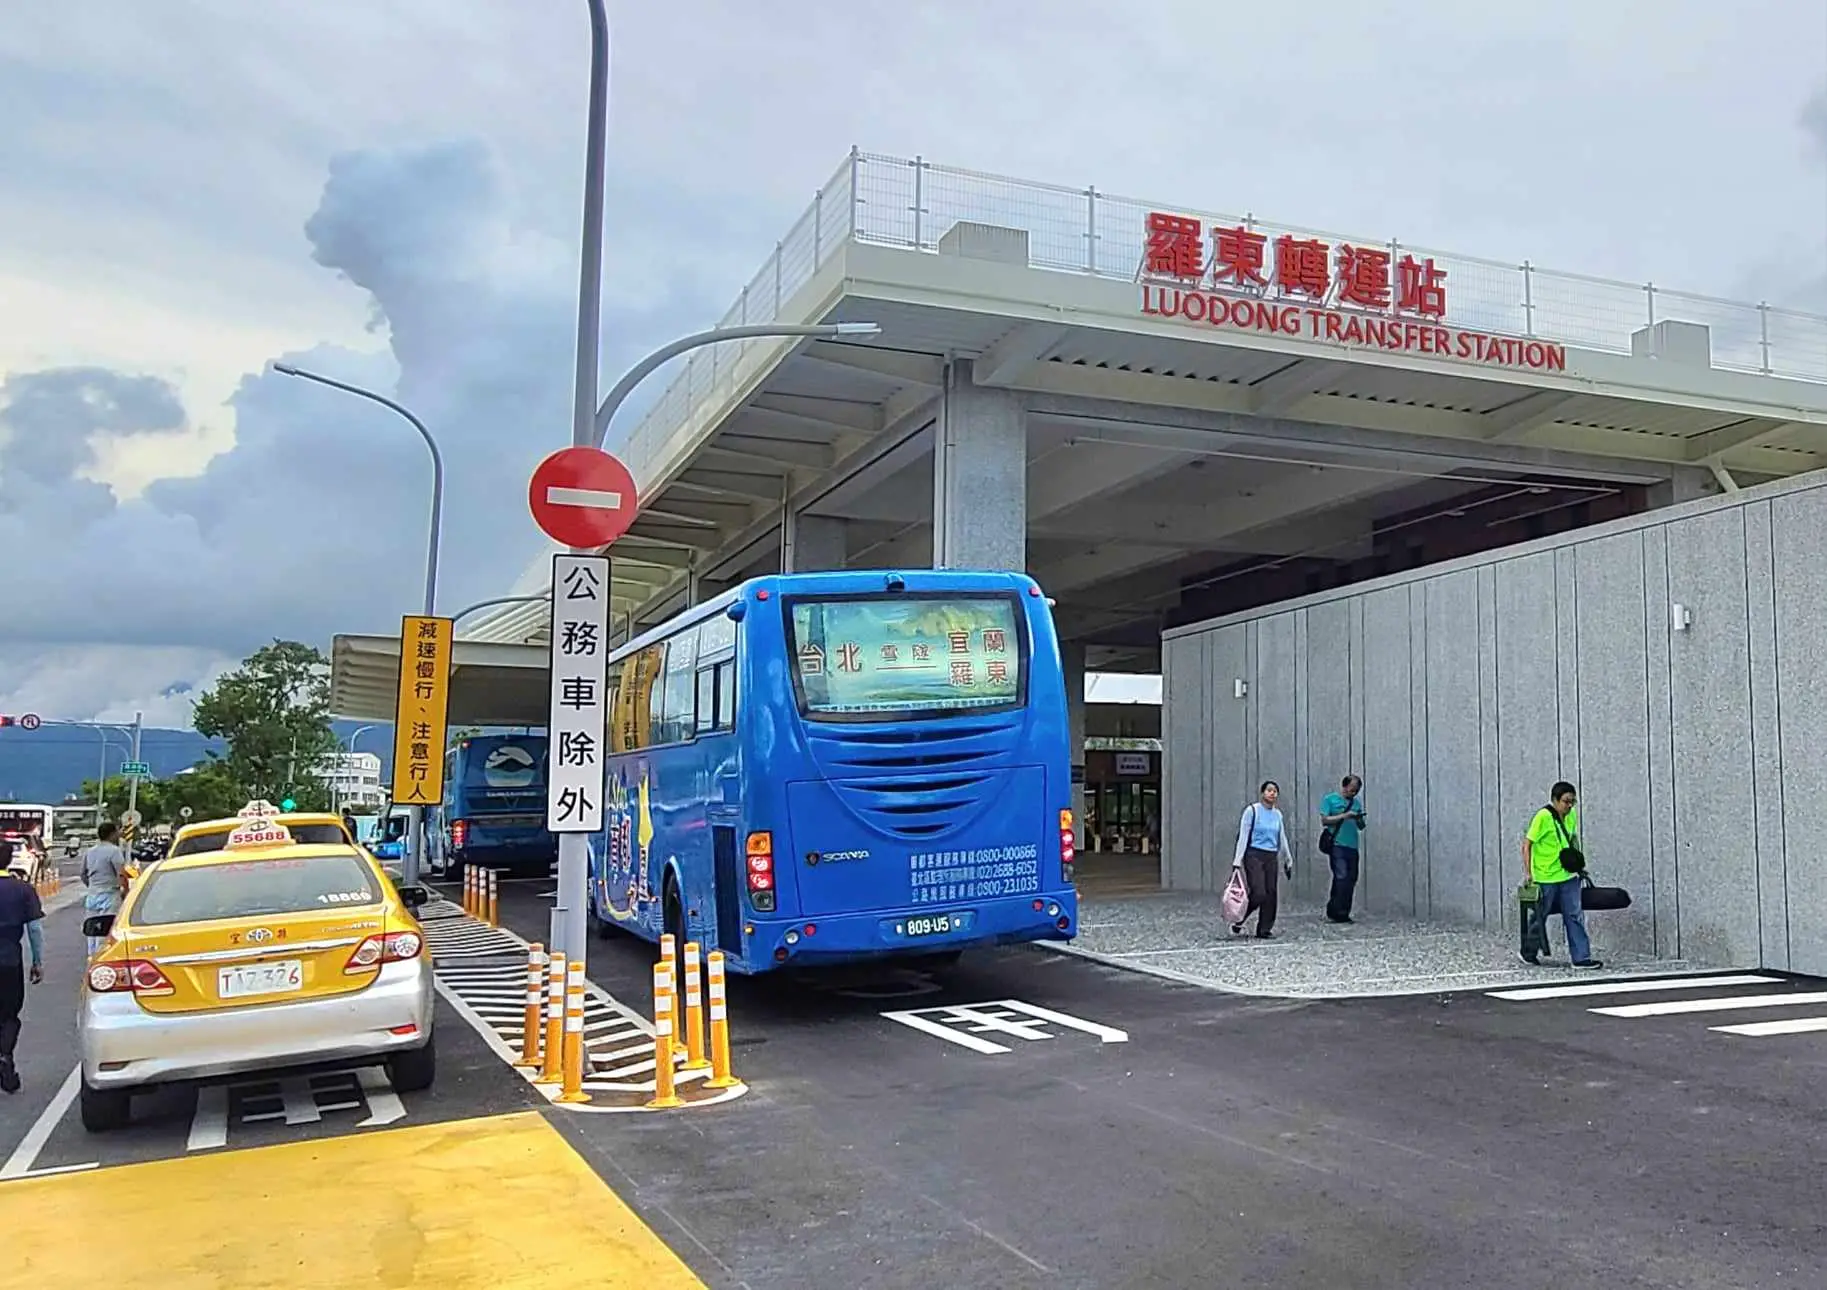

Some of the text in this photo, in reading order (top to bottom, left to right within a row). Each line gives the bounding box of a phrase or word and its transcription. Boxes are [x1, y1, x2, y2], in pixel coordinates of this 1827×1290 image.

[1146, 212, 1447, 317] 羅東轉運站
[1142, 284, 1566, 371] LUODONG TRANSFER STATION
[948, 628, 1005, 655] 宜蘭
[798, 643, 862, 676] 台北
[950, 660, 1008, 687] 羅東
[556, 566, 599, 823] 公務車除外
[408, 621, 437, 801] 減速慢行、注意行人
[233, 832, 285, 843] 55688
[823, 851, 870, 862] SCANIA
[908, 916, 949, 935] 809-U5
